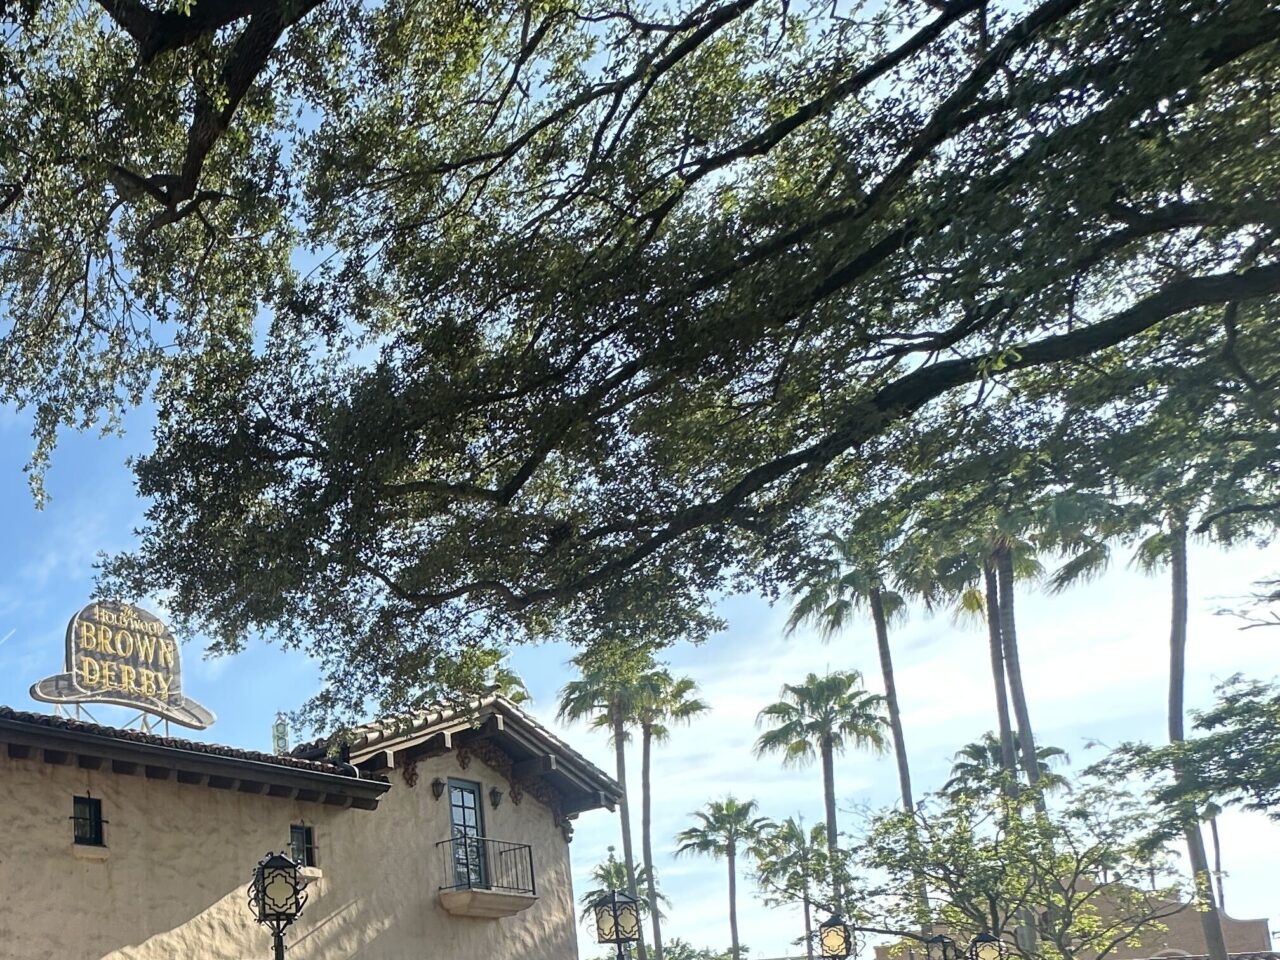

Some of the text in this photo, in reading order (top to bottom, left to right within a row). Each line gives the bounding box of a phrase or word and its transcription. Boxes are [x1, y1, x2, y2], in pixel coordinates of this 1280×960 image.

[93, 604, 165, 636] HOLLYWOOD
[119, 605, 139, 620] The
[79, 621, 174, 668] BROWN
[81, 656, 173, 700] DERBY
